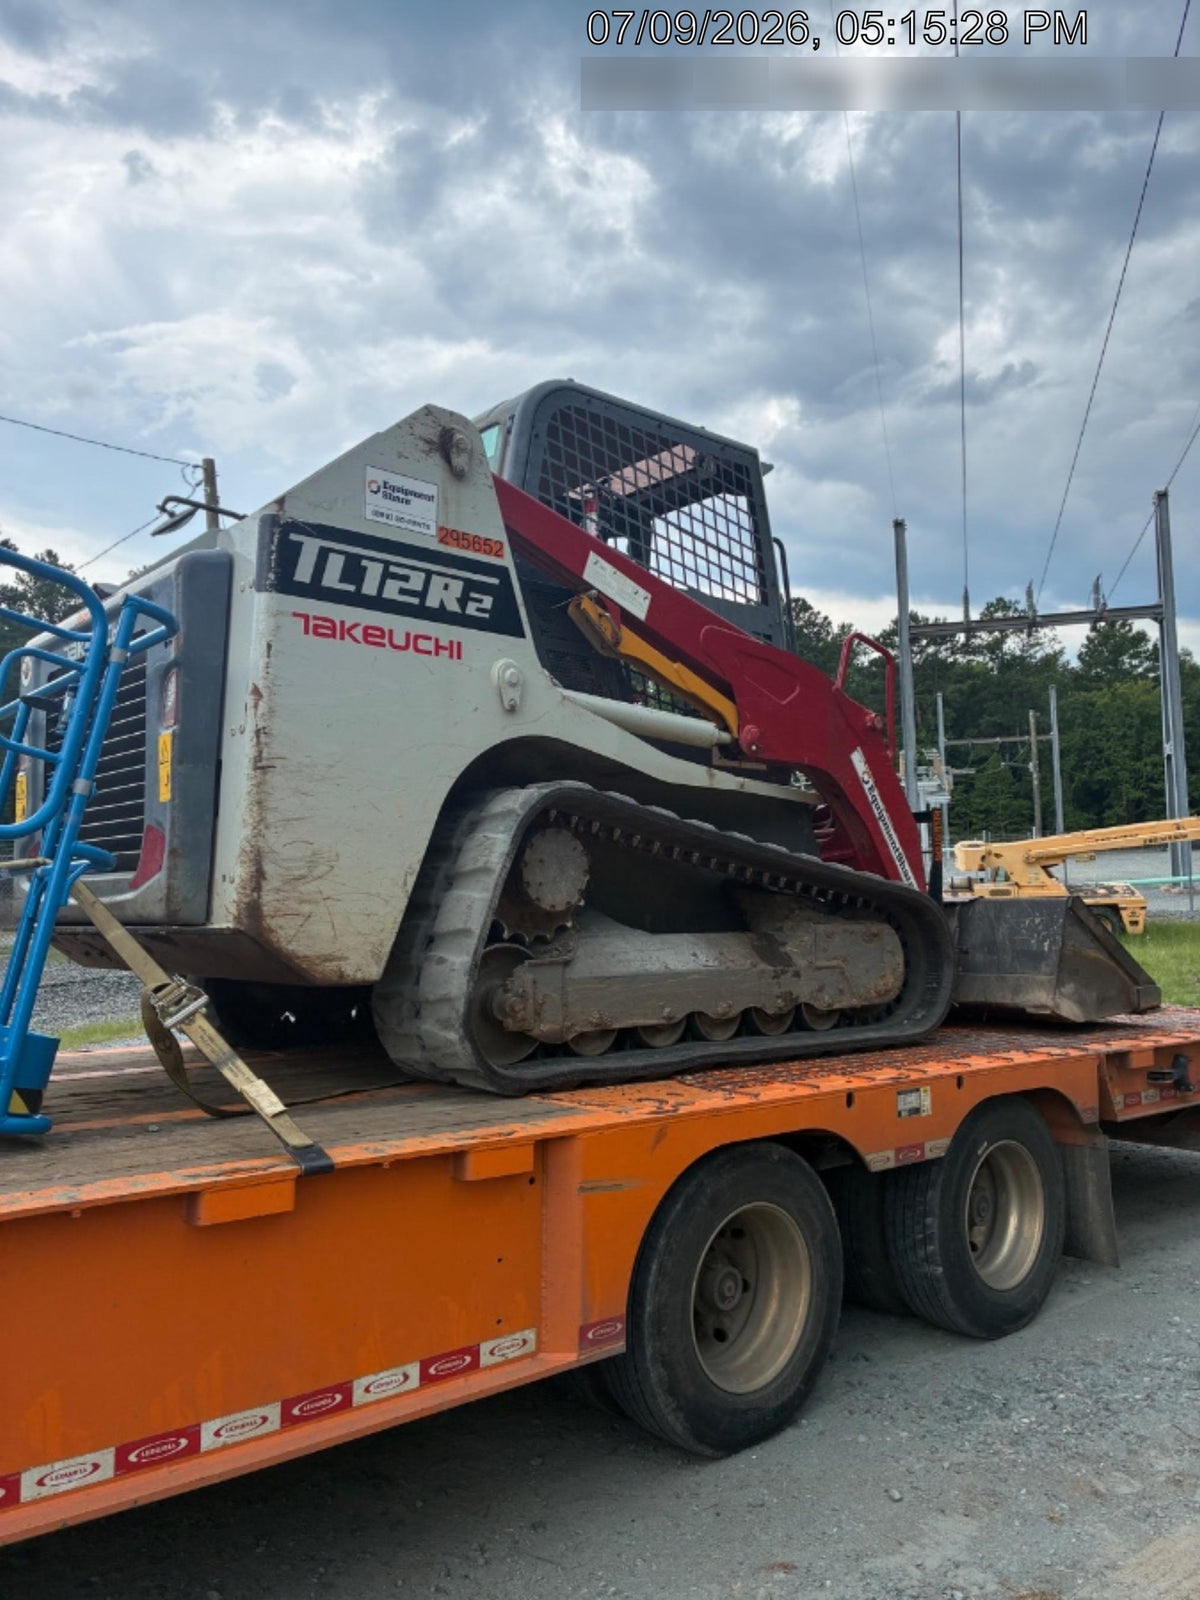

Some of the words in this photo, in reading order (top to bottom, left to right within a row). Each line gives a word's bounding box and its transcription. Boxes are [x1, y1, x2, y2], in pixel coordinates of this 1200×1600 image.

[382, 479, 434, 503] Equipment
[438, 526, 504, 558] 295652
[288, 532, 500, 619] TL12R2
